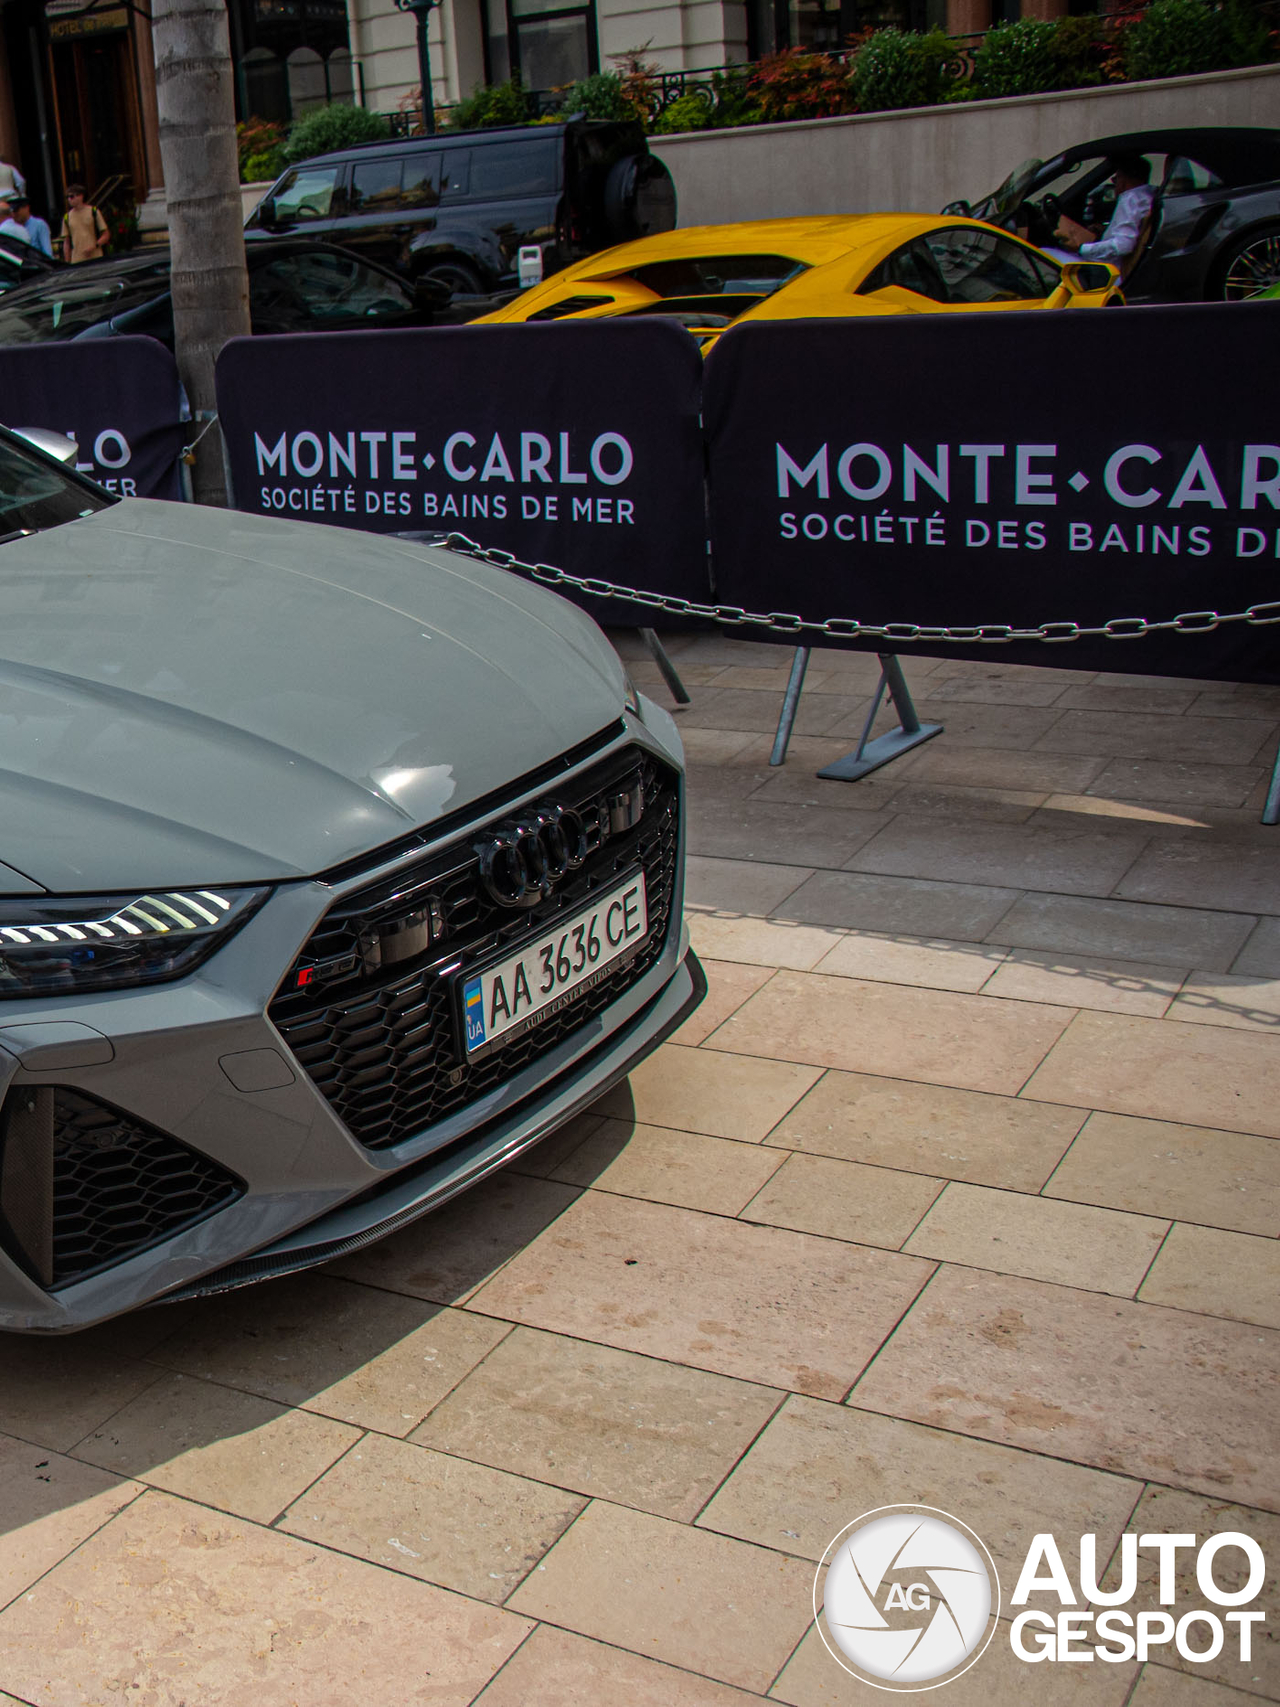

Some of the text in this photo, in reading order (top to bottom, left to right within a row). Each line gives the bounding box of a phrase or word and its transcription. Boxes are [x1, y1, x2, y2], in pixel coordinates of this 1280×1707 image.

[97, 477, 137, 497] ER
[260, 483, 635, 525] SOCIÉTÉ DES BAINS DE MER
[779, 508, 1280, 559] SOCIÉTÉ DES BAINS D
[490, 886, 641, 1029] AA 3636 CE
[524, 1009, 547, 1031] AUDI
[550, 986, 584, 1014] CENTER
[468, 1022, 484, 1040] UA
